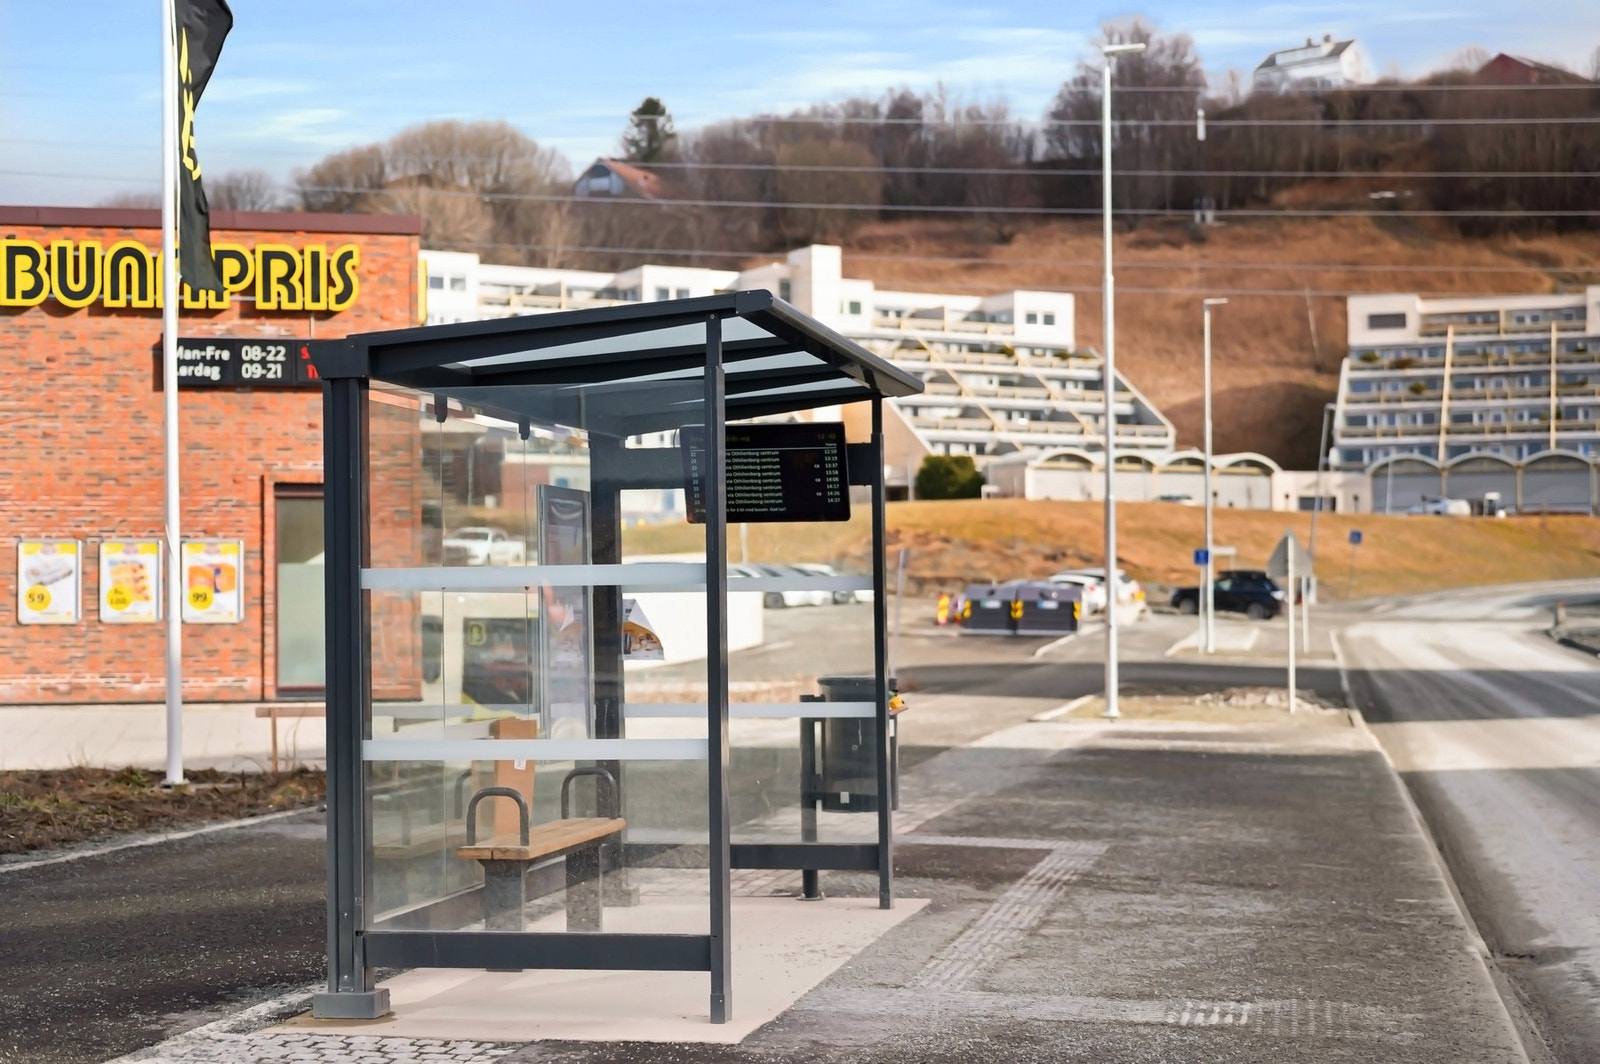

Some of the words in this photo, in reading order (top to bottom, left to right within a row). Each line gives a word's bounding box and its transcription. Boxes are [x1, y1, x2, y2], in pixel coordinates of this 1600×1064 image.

[0, 239, 361, 312] BUNPRIS
[241, 345, 287, 361] 08-22
[177, 362, 221, 381] ørdag
[241, 362, 283, 379] 09-21
